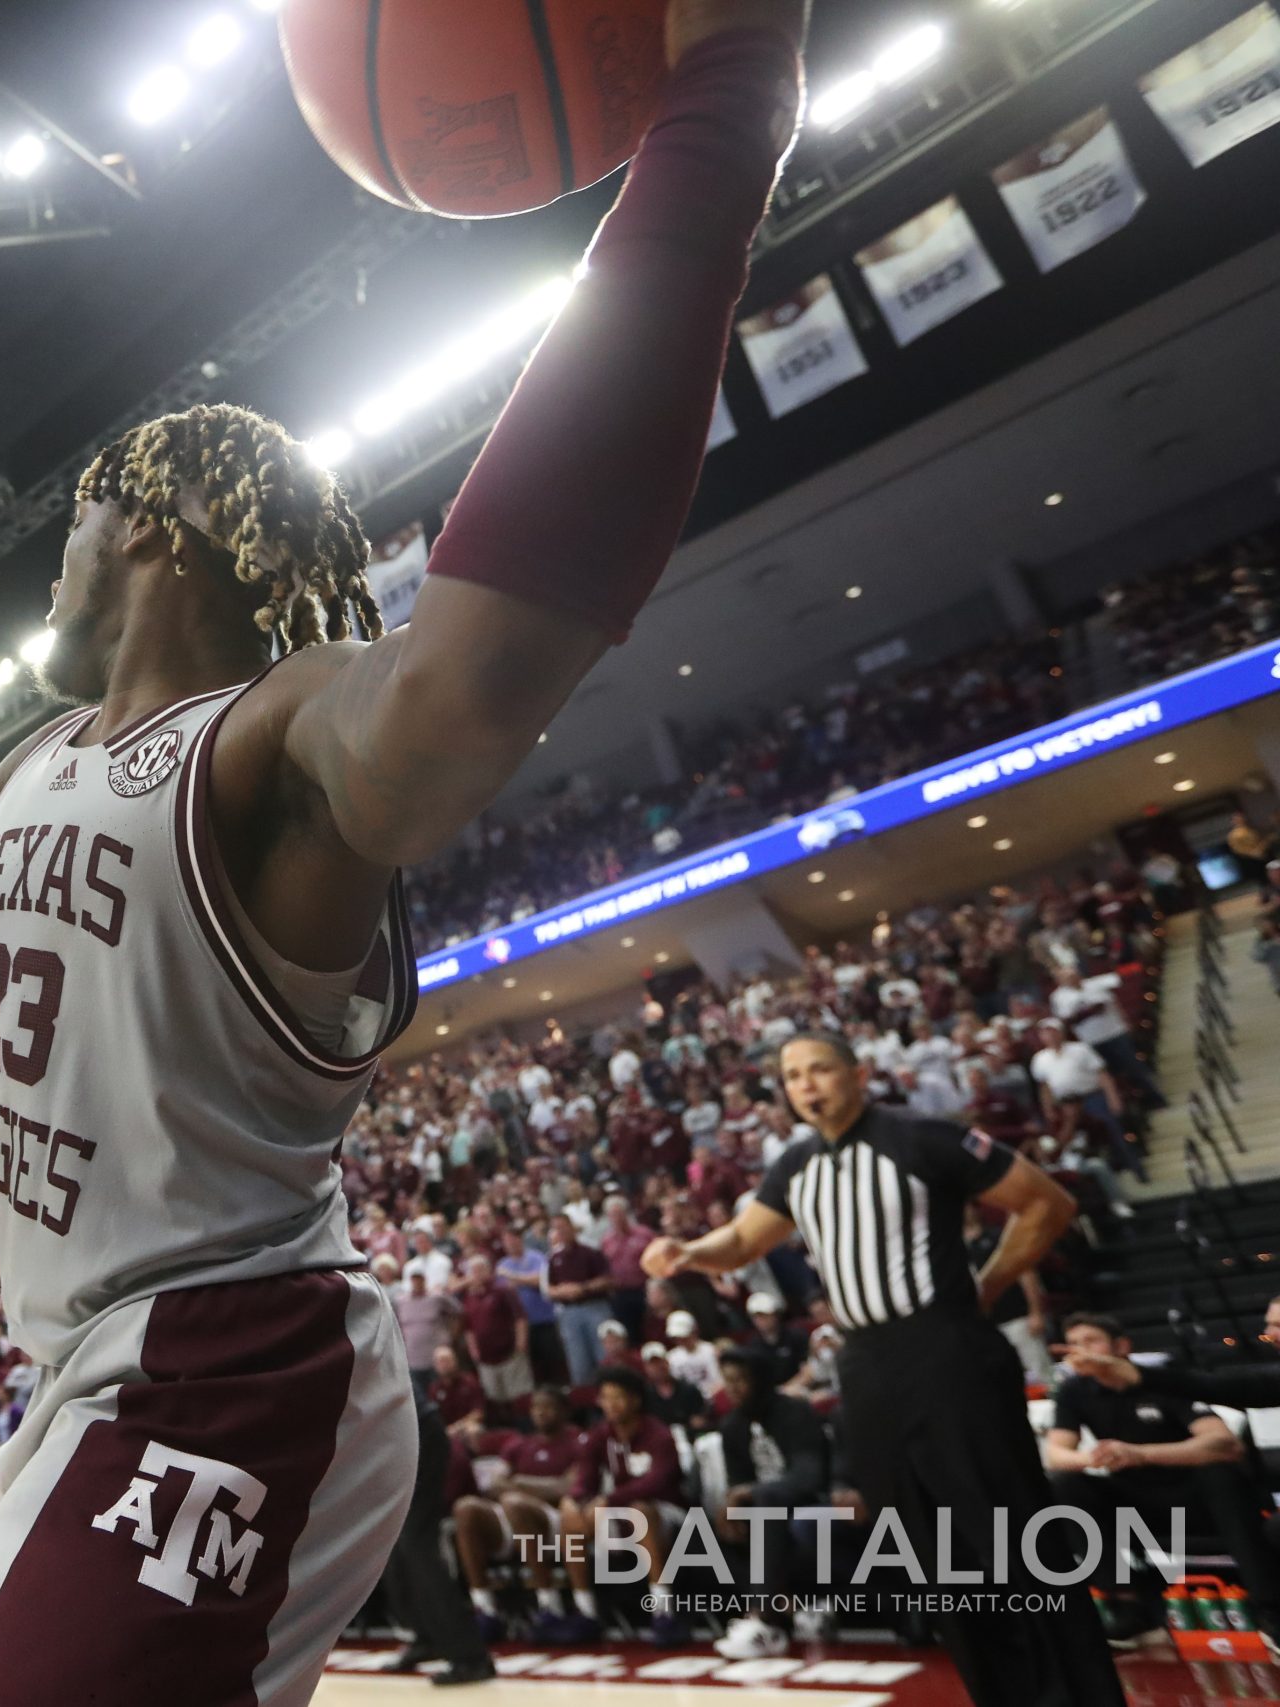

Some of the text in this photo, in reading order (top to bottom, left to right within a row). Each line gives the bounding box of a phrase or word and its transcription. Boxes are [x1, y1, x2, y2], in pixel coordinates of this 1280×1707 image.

[1040, 175, 1121, 234] 1922
[129, 732, 178, 778] SEC
[998, 747, 1037, 775] TO
[48, 777, 78, 791] adidas
[111, 771, 164, 795] GRADUATE
